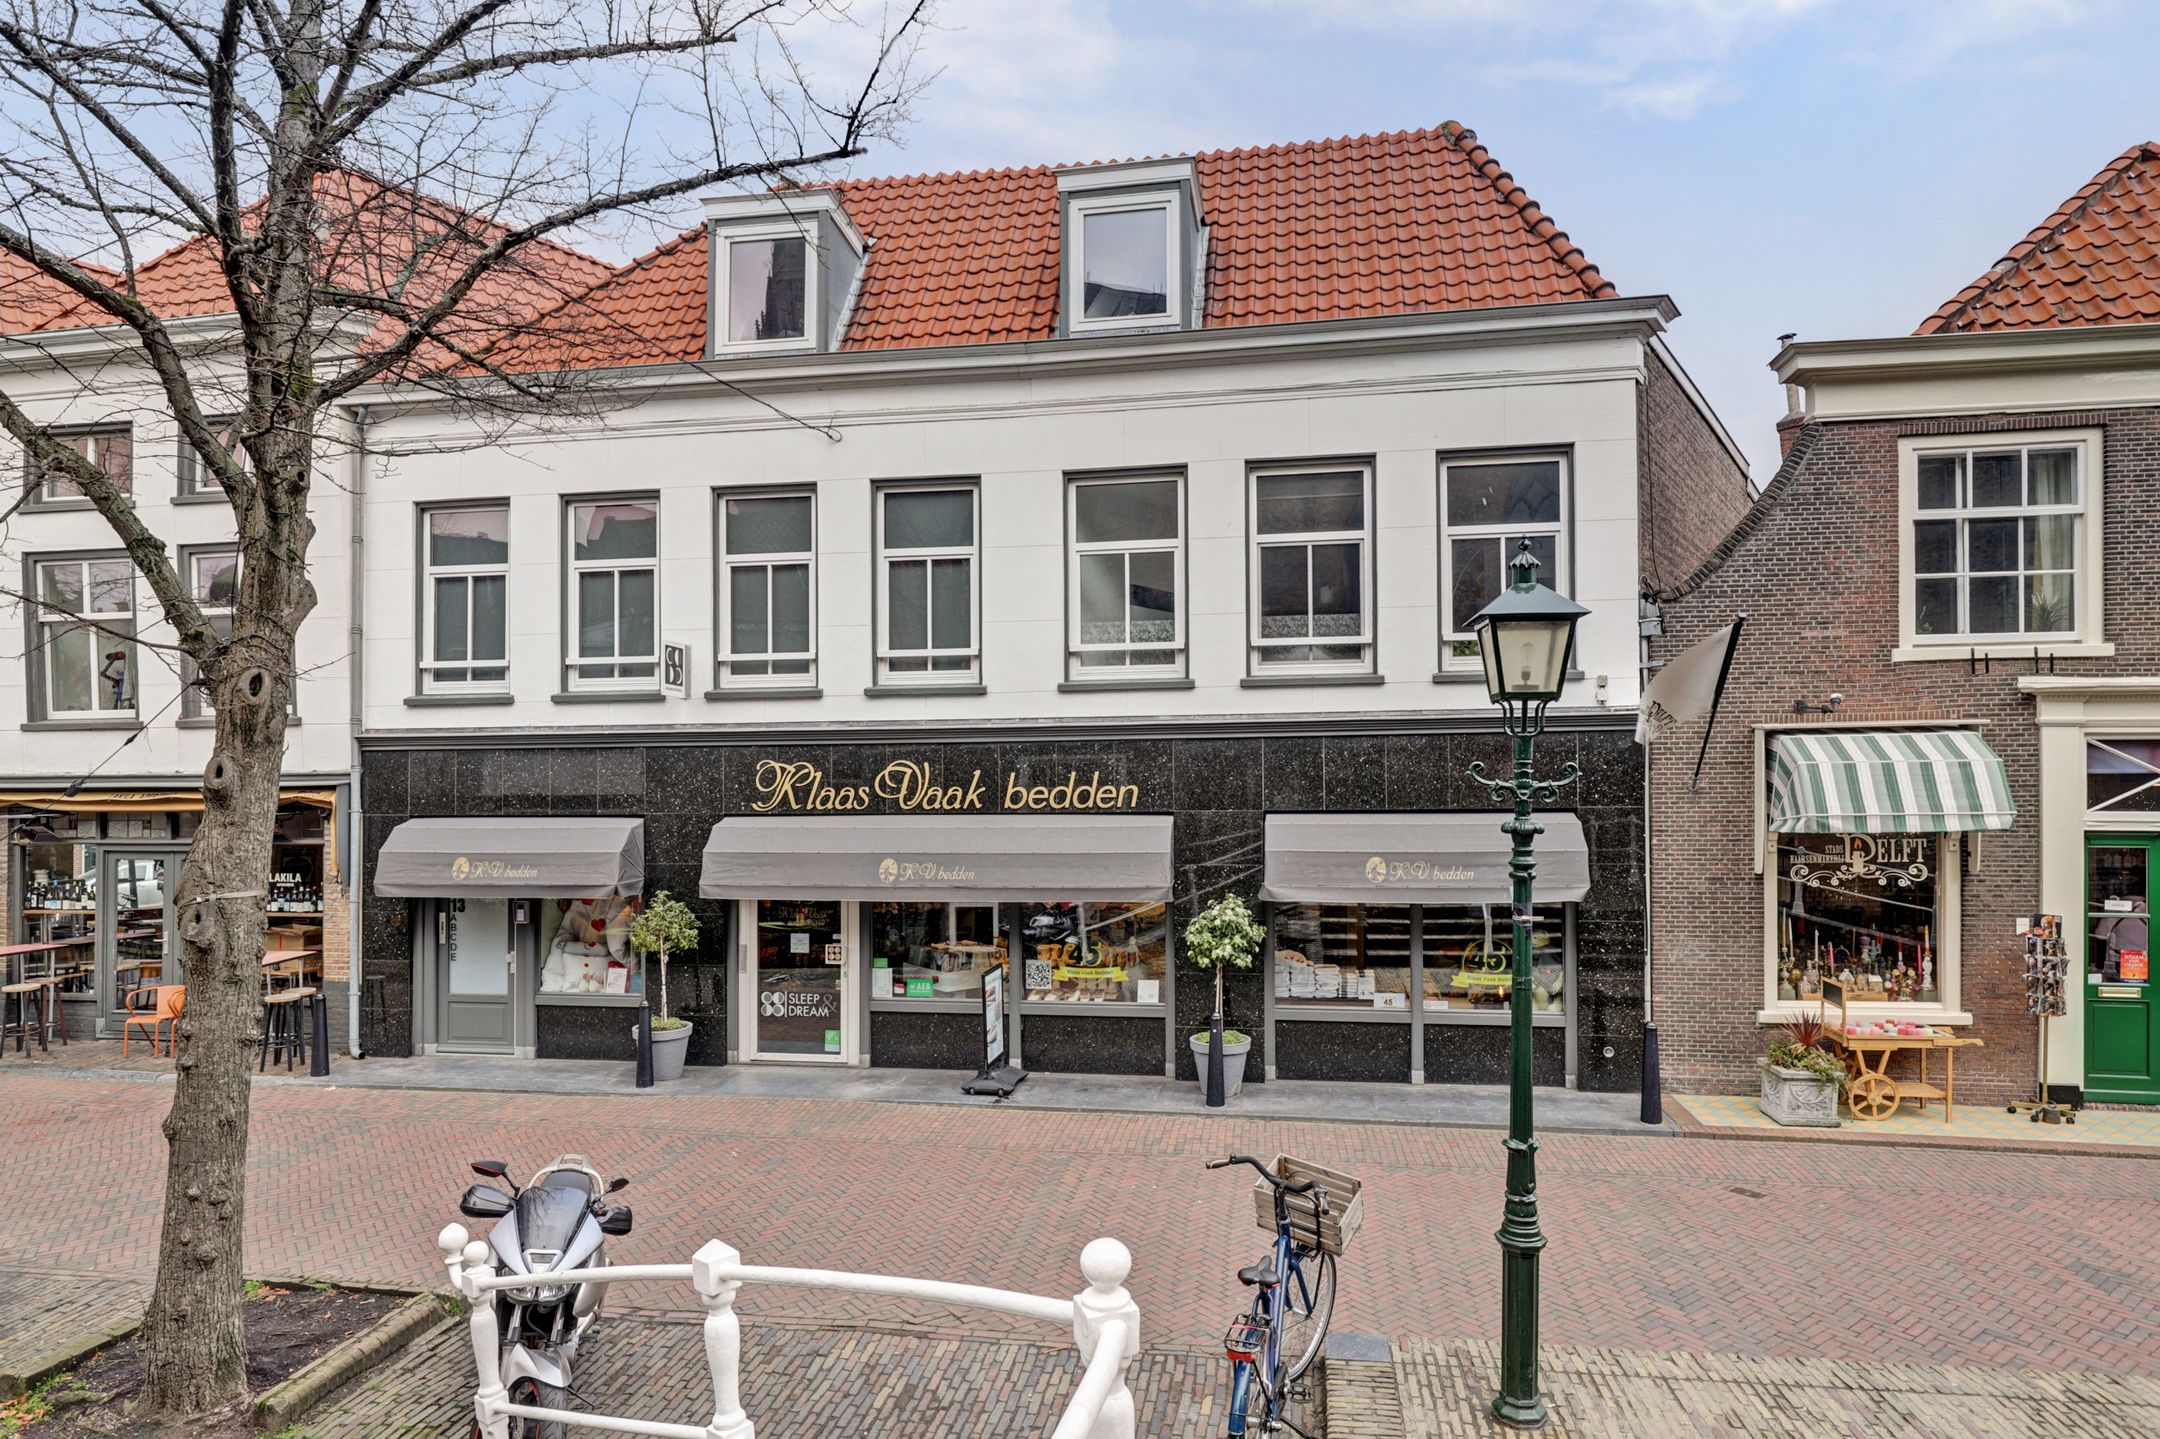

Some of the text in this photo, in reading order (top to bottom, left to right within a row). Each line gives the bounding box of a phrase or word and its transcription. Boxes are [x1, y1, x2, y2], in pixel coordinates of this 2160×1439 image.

[752, 760, 1139, 811] Klaas Vaak bedden
[1825, 845, 1844, 854] STADS
[269, 873, 302, 883] LAKILA
[504, 865, 538, 878] bedden
[938, 866, 975, 880] bedden
[1433, 865, 1474, 880] bedden
[450, 898, 465, 912] 13
[789, 993, 838, 1013] SLEEP &
[789, 1006, 829, 1017] DREAM
